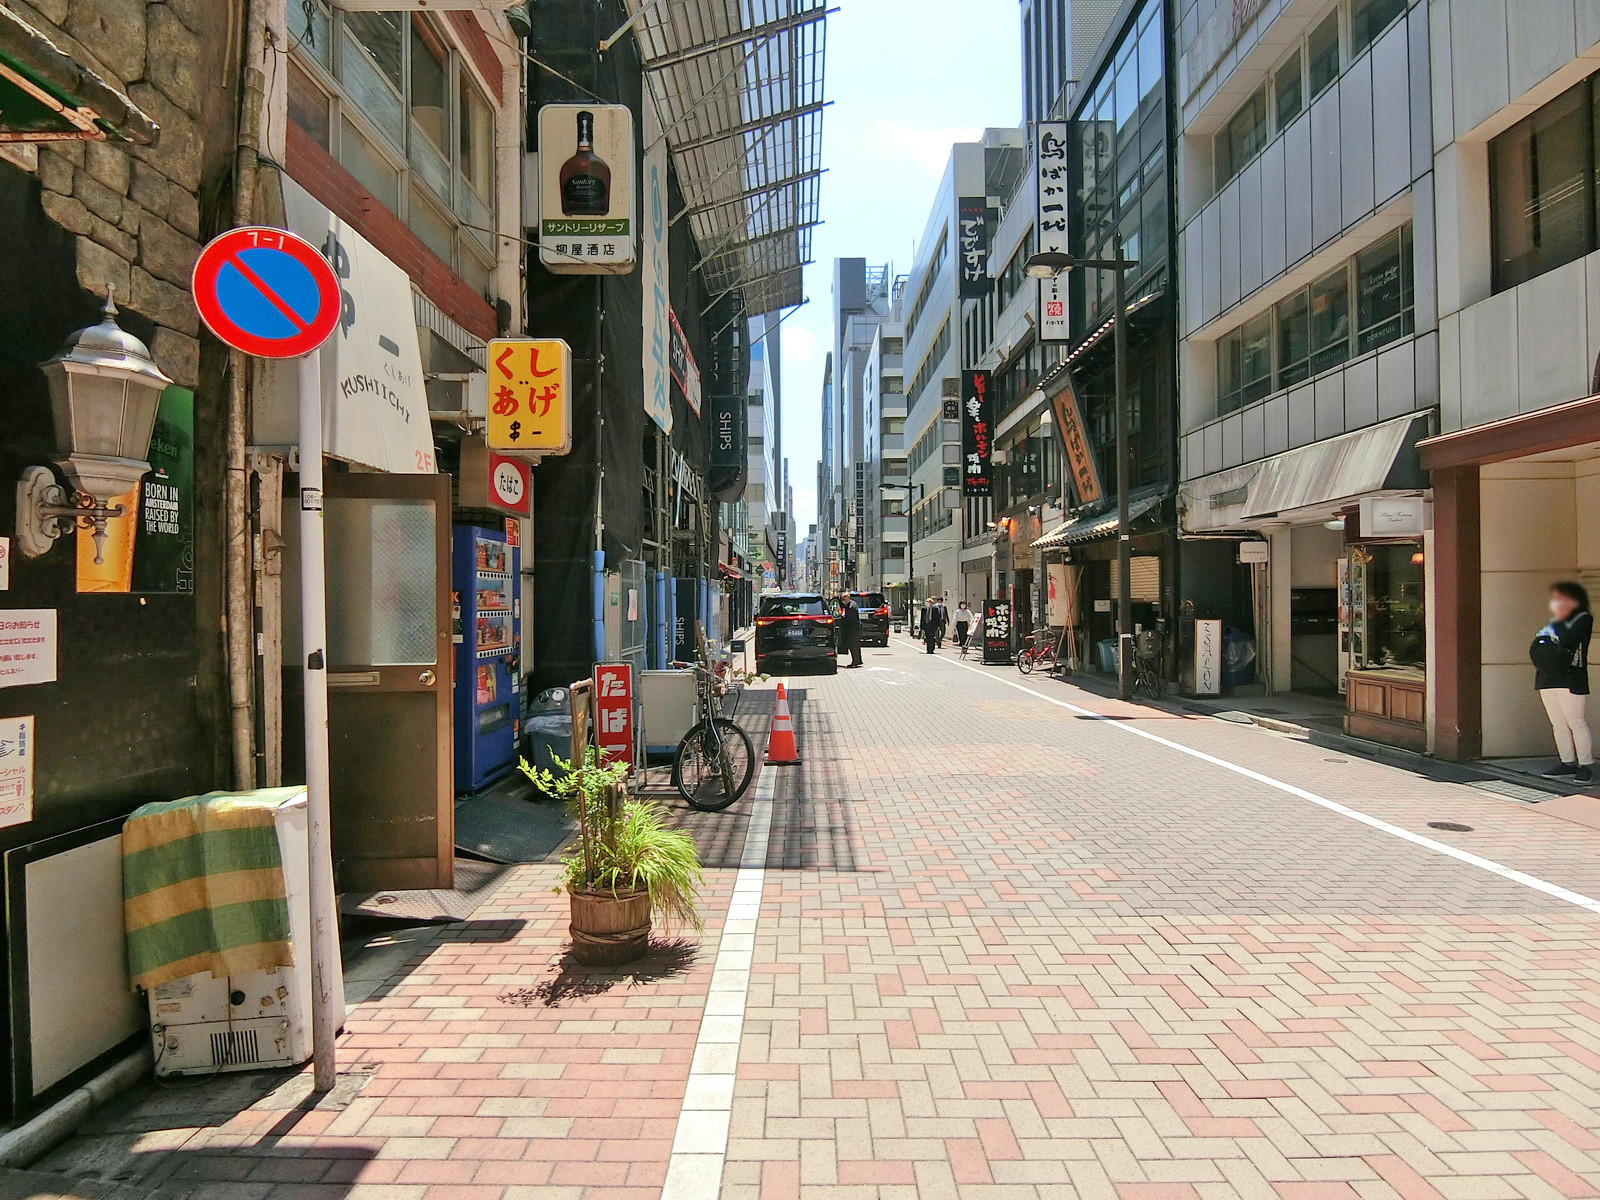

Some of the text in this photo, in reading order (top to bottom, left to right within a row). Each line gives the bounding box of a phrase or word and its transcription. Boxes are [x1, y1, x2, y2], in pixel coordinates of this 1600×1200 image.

[547, 222, 625, 233] サントリーリザーブ
[247, 231, 284, 250] 7-1
[555, 243, 615, 256] 柳屋酒店
[383, 362, 412, 388] くしあげ
[340, 374, 411, 425] KUSHIICHI
[720, 412, 732, 450] SHIPS
[973, 422, 988, 458] ホルモン
[415, 449, 433, 473] 2F
[967, 452, 981, 474] 焼肉
[145, 482, 179, 502] BORN IN
[499, 471, 519, 496] たばこ
[145, 498, 179, 510] AMSTERDAM
[145, 507, 179, 523] RAISED BY
[146, 520, 179, 534] THE WORLD
[676, 617, 685, 645] SHIPS
[985, 617, 999, 637] 焼肉
[995, 604, 1009, 638] ホルモン
